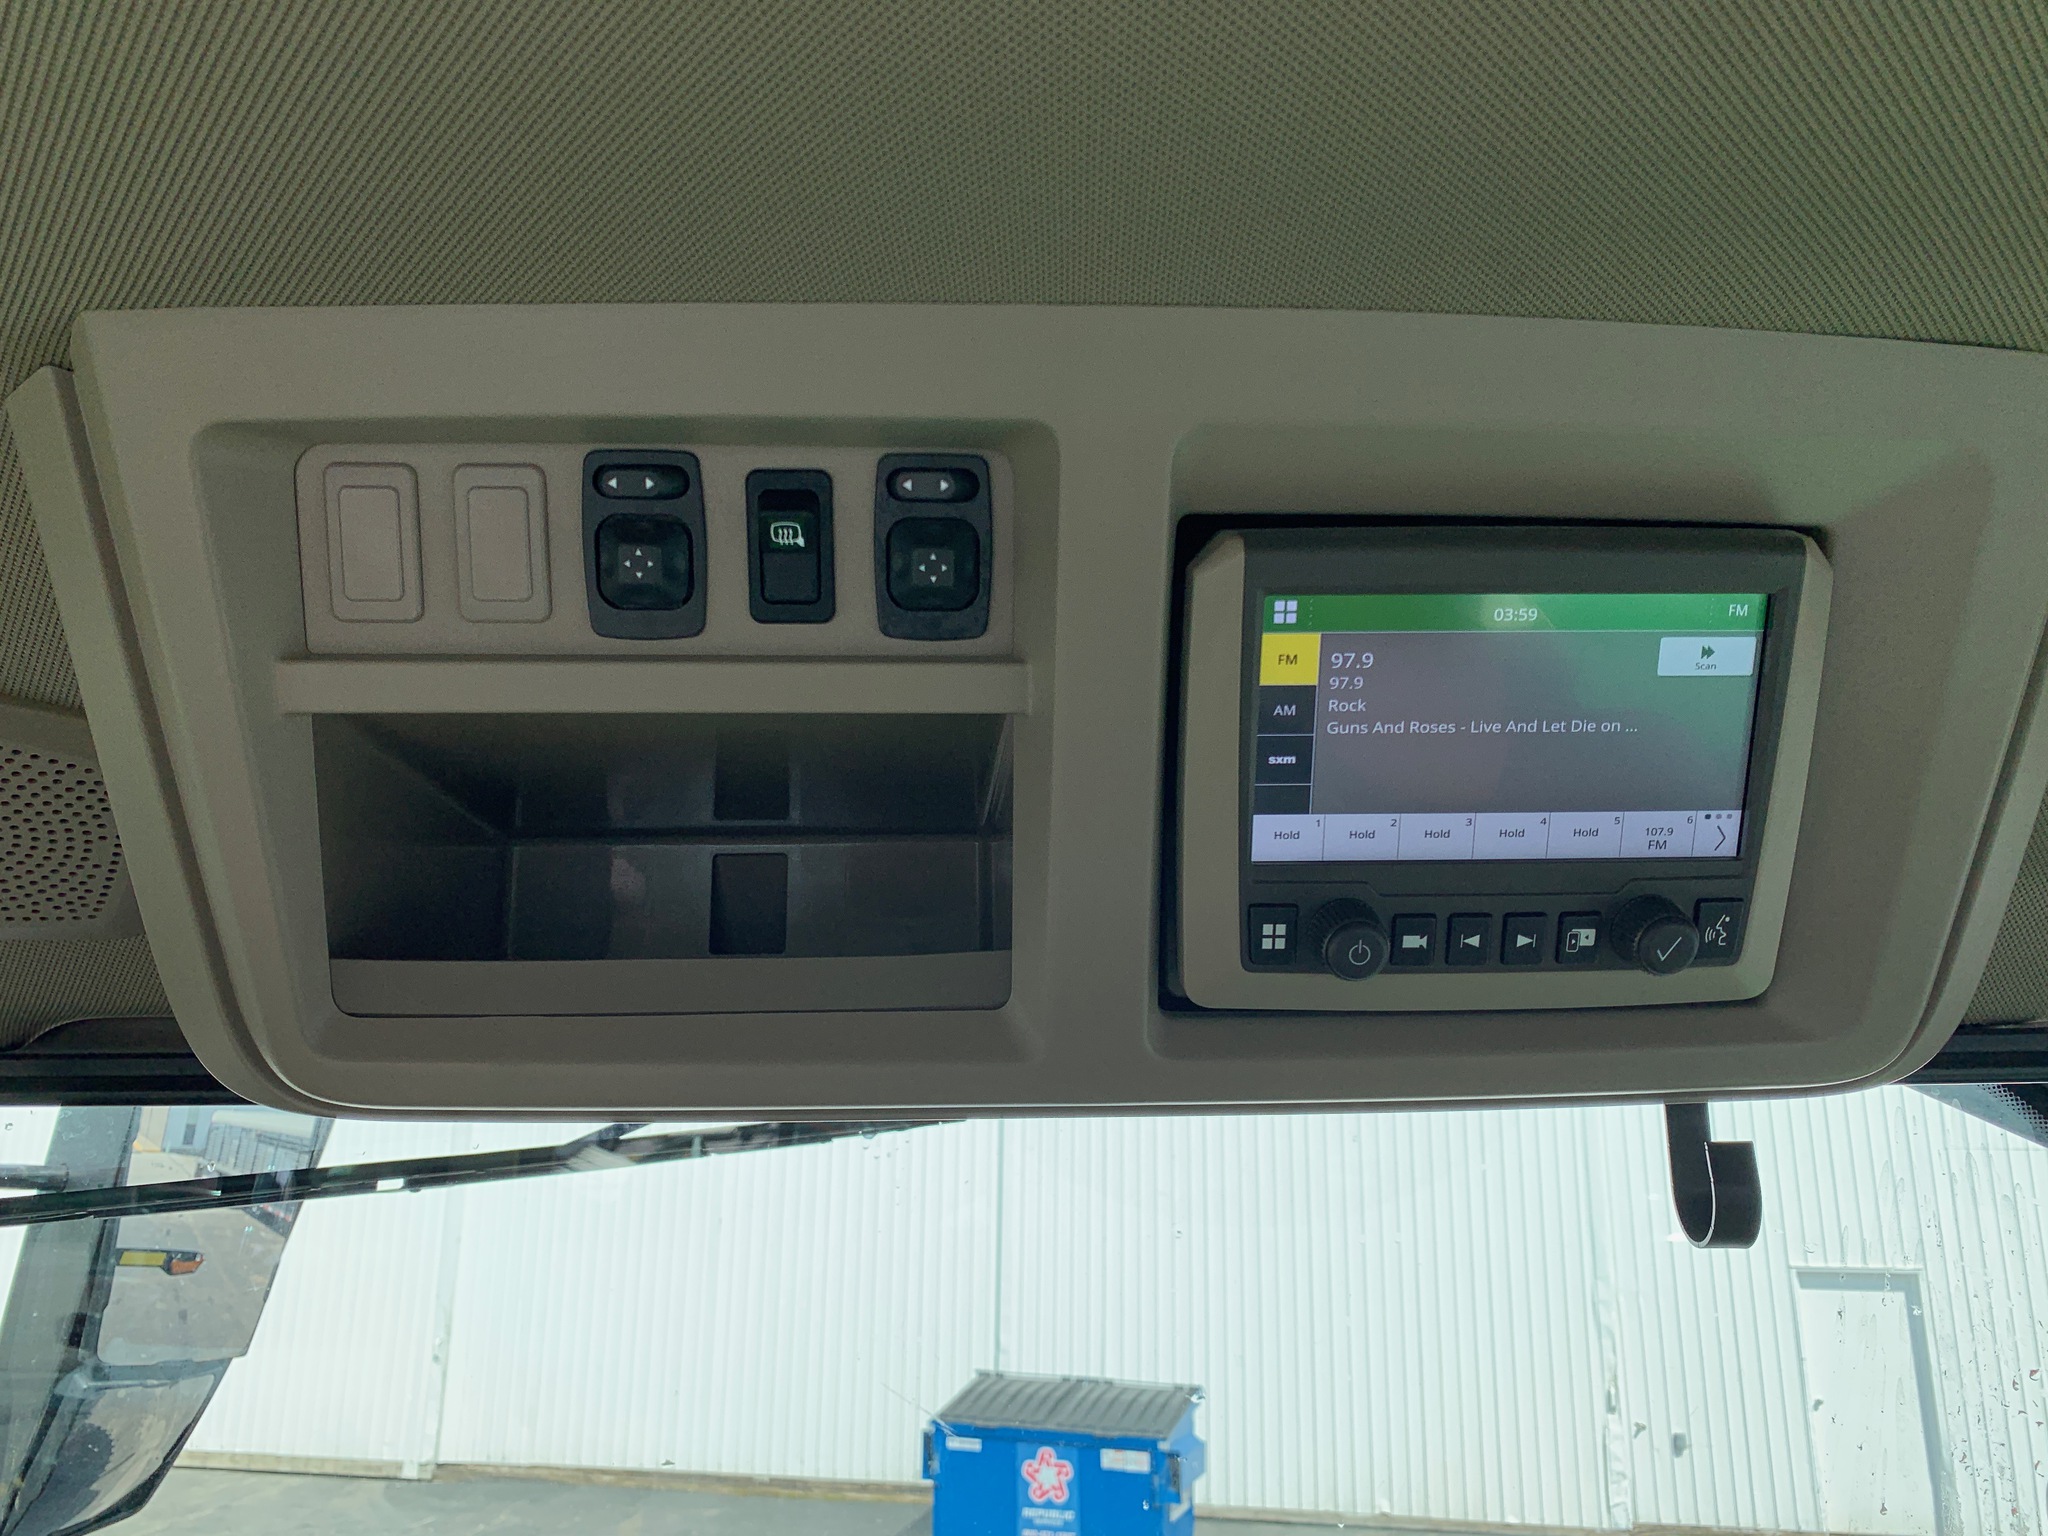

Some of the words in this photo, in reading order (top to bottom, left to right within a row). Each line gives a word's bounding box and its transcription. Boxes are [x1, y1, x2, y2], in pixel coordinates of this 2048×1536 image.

[1493, 607, 1538, 622] 03:59
[1728, 604, 1749, 617] FM
[1278, 654, 1298, 665] FM
[1330, 652, 1374, 670] 97.9
[1694, 662, 1717, 671] Scan
[1329, 676, 1364, 690] 97.9
[1273, 704, 1296, 716] AM
[1328, 698, 1367, 713] Rock
[1326, 721, 1369, 735] Guns
[1372, 720, 1405, 734] And
[1409, 720, 1456, 734] Roses
[1470, 720, 1502, 733] Live
[1505, 720, 1538, 733] And
[1542, 720, 1566, 733] Let
[1571, 719, 1597, 733] Die
[1600, 722, 1621, 733] on
[1268, 755, 1296, 764] sxm
[1315, 819, 1322, 828] 1
[1390, 818, 1398, 828] 2
[1465, 818, 1473, 827] 3
[1540, 817, 1547, 826] 4
[1614, 816, 1621, 826] 5
[1687, 815, 1694, 825] 6
[1273, 830, 1300, 840] Hold
[1349, 830, 1376, 840] Hold
[1424, 829, 1451, 839] Hold
[1499, 828, 1525, 838] Hold
[1573, 827, 1599, 837] Hold
[1645, 827, 1674, 837] 107.9
[1648, 840, 1667, 850] FM
